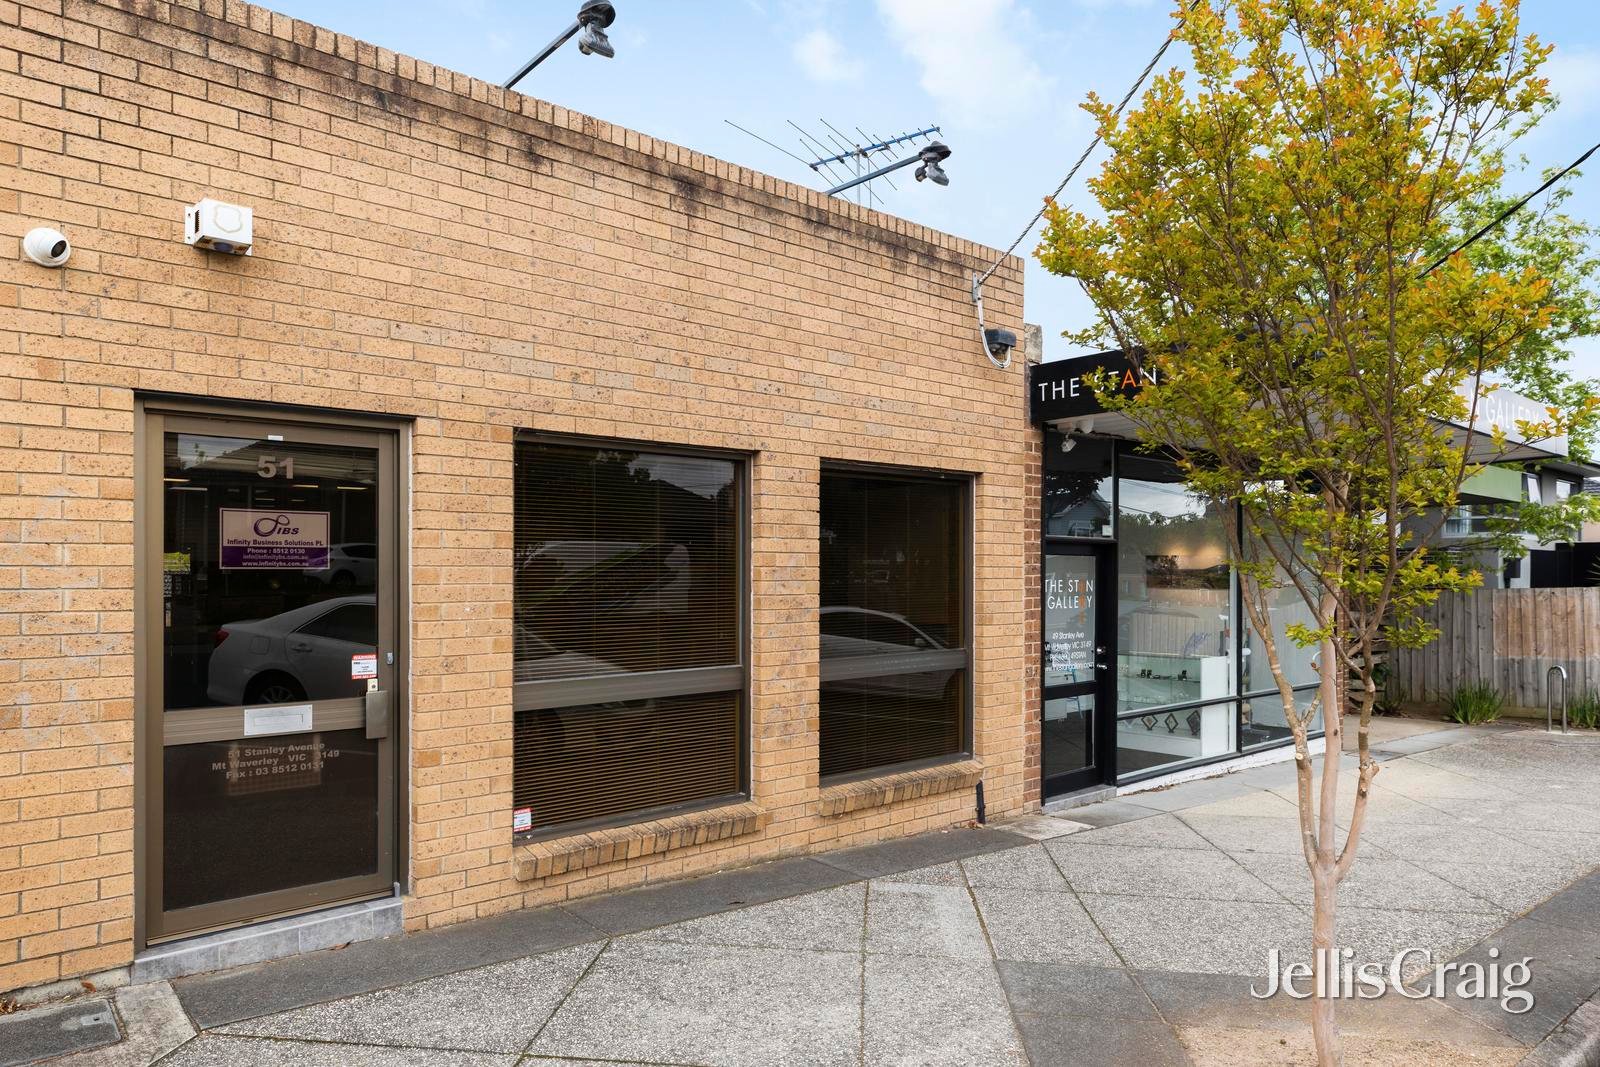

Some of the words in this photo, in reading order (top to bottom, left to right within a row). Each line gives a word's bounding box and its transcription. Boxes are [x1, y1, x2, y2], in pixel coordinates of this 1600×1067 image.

[1038, 377, 1080, 402] THE
[257, 455, 294, 480] 51
[277, 527, 300, 535] IBS
[227, 538, 251, 546] Infinity
[1044, 579, 1063, 593] THE
[245, 745, 286, 757] Stanley
[287, 743, 325, 753] Avenue
[212, 762, 226, 771] Mt
[229, 757, 279, 769] Waverley
[288, 753, 307, 762] VIC
[225, 770, 246, 780] Fax
[255, 767, 269, 776] 03
[272, 764, 298, 774] 8512
[300, 761, 324, 771] 0131
